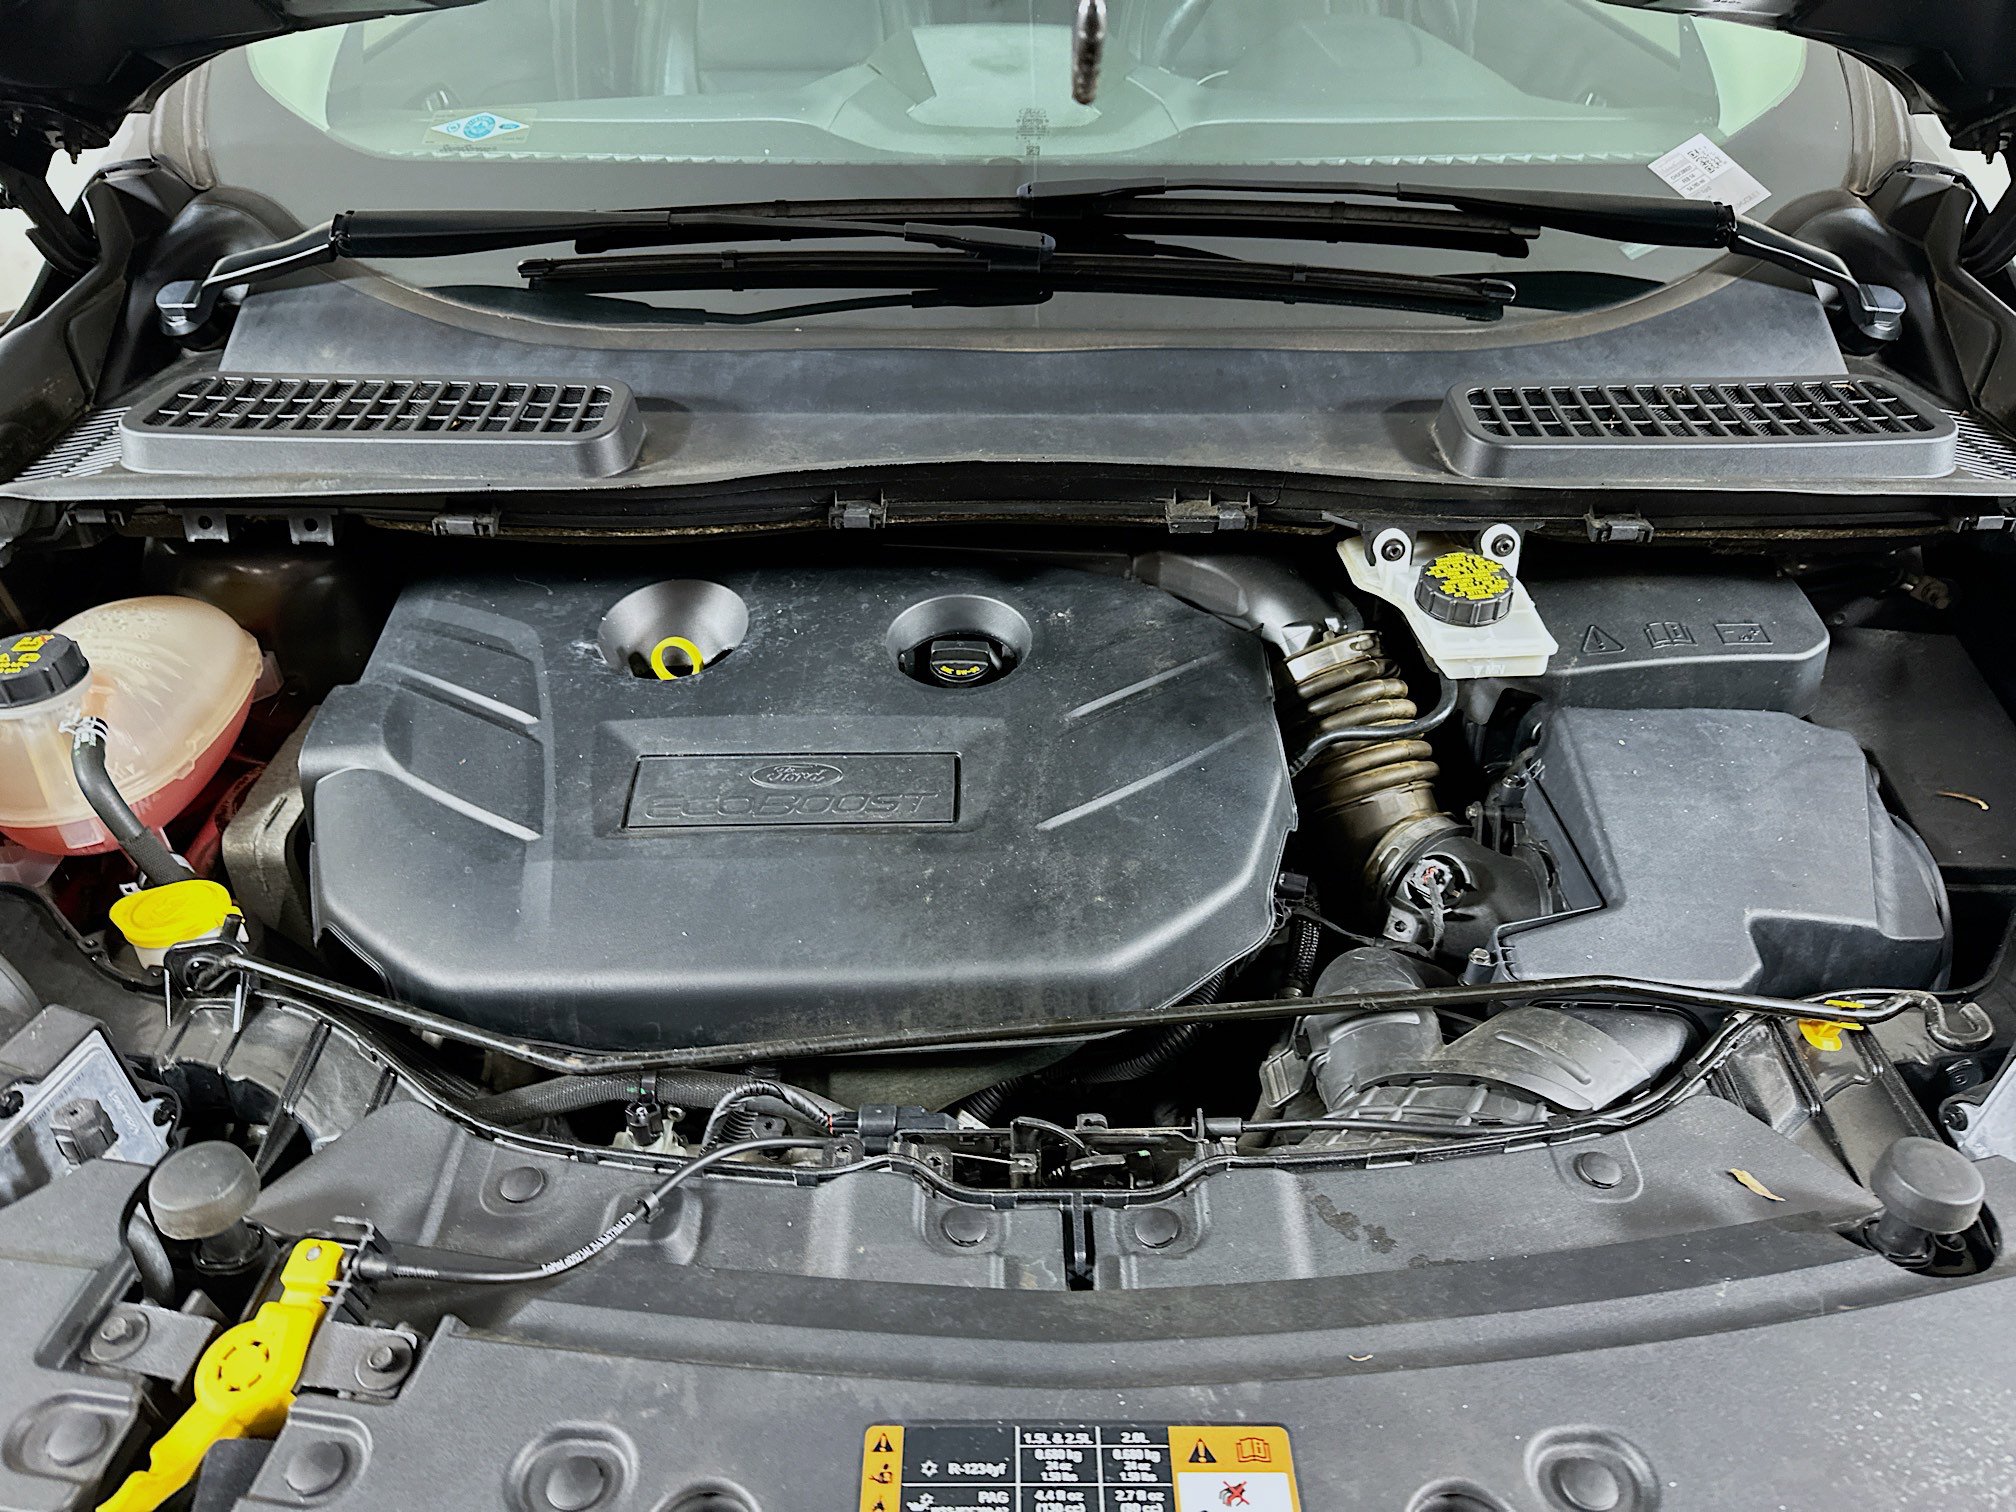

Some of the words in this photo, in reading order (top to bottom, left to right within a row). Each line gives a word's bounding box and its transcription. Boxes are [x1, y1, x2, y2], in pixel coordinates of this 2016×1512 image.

[767, 765, 825, 784] Ford
[1023, 1432, 1051, 1444] 1.5L
[1052, 1432, 1064, 1444] &
[1065, 1432, 1094, 1444] 2.5L
[1121, 1431, 1150, 1444] 2.0L
[948, 1462, 1007, 1478] R-1234yf
[977, 1490, 1010, 1504] PAG
[1034, 1489, 1055, 1502] 4.4
[1114, 1489, 1135, 1502] 2.7
